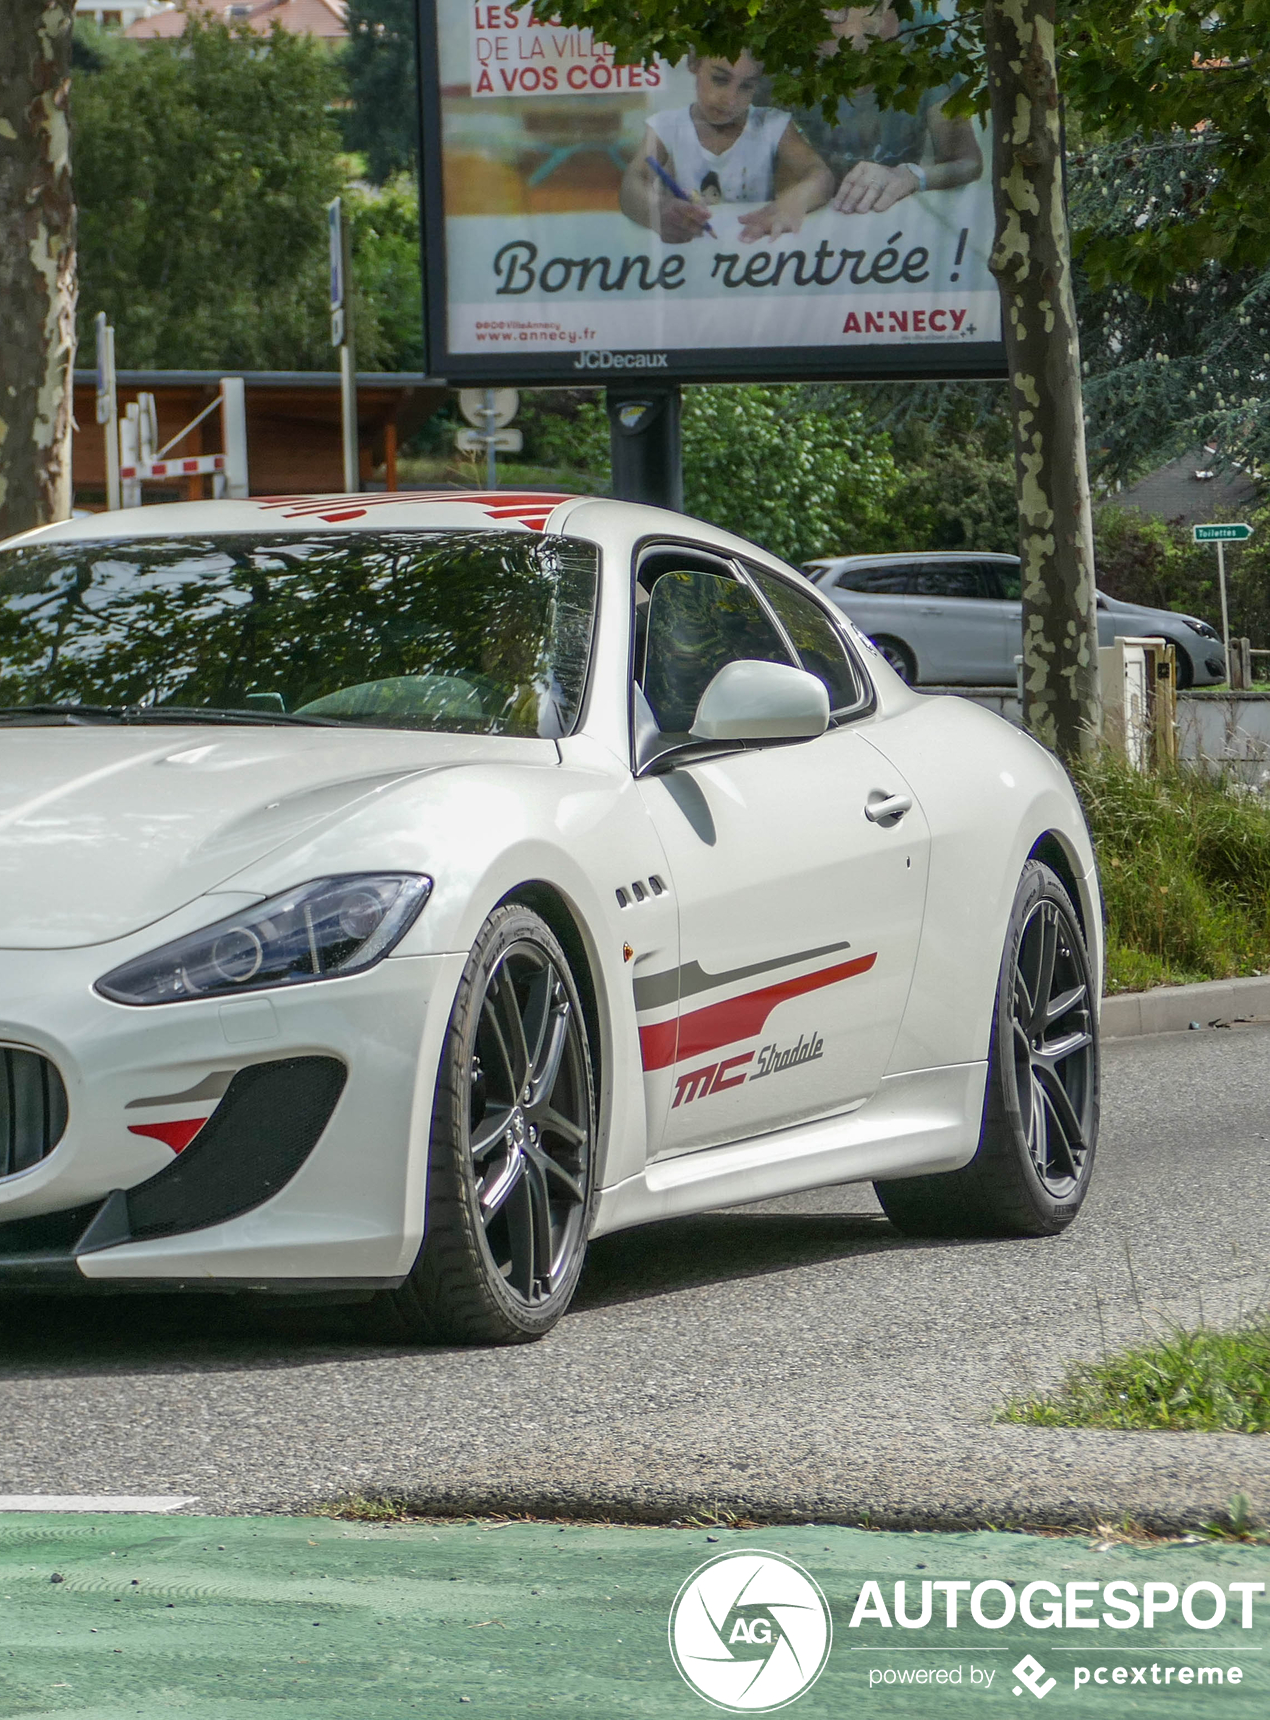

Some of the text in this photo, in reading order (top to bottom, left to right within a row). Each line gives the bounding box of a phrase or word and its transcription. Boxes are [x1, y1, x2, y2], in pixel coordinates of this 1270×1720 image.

[475, 5, 520, 30] LES
[476, 36, 509, 61] DE
[518, 35, 545, 60] LA
[476, 56, 661, 93] À VOS CÔTES
[493, 227, 968, 295] Bonne rentrée !
[842, 309, 968, 334] ANNECY
[475, 328, 597, 344] www.annecy.fr
[573, 350, 669, 370] JCDecaux
[1198, 529, 1237, 538] Toilettes
[748, 1030, 825, 1082] Stradale
